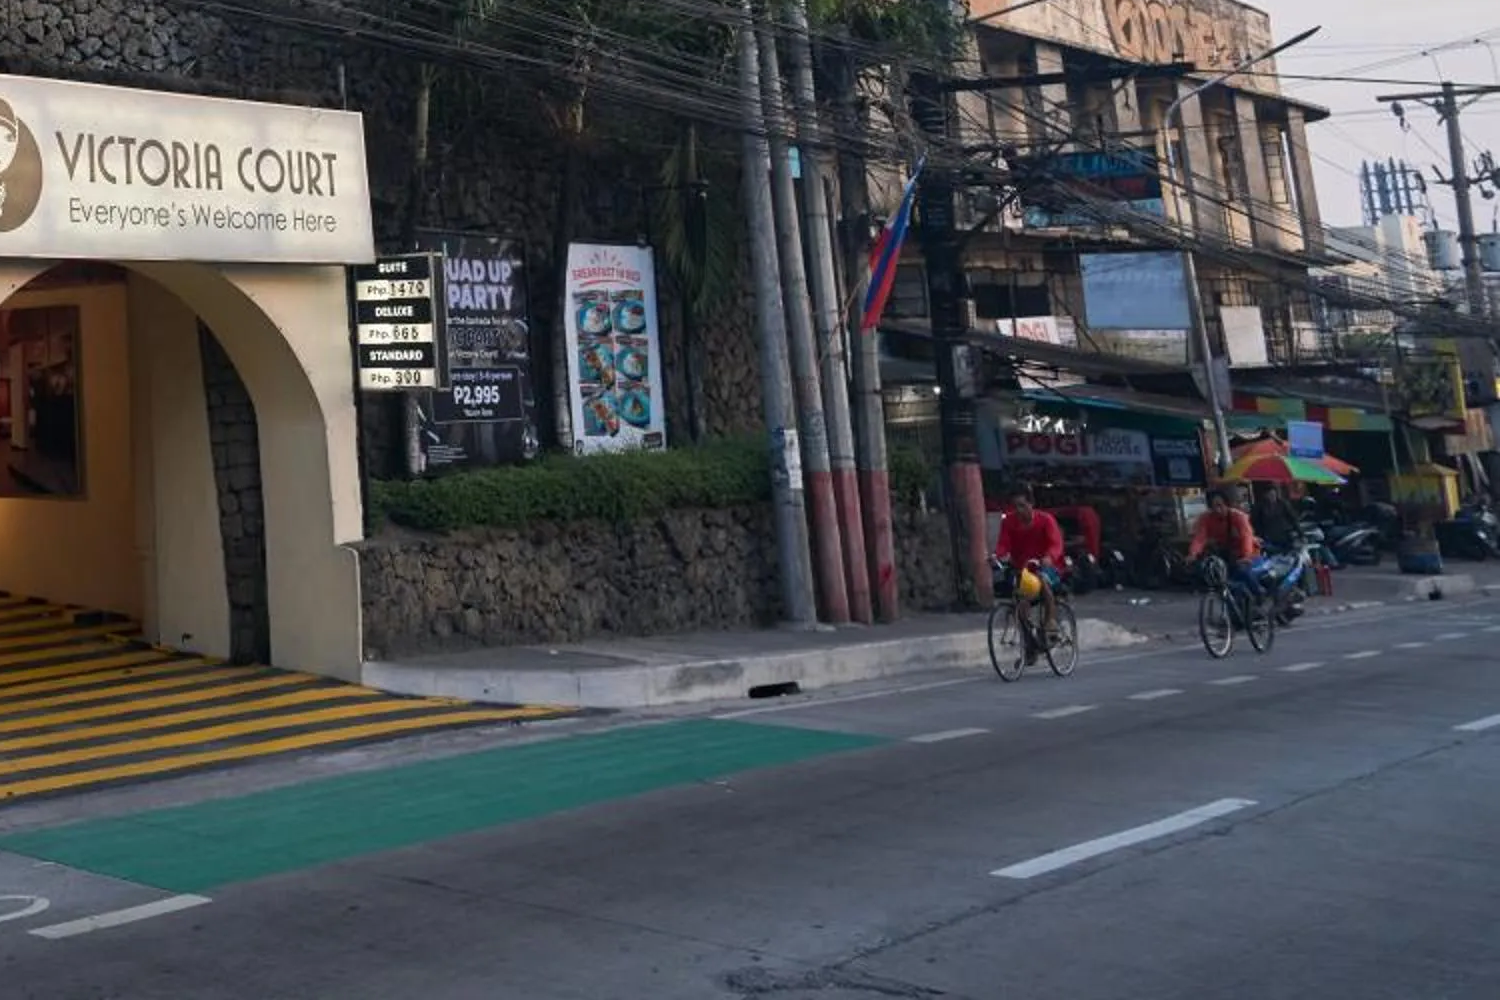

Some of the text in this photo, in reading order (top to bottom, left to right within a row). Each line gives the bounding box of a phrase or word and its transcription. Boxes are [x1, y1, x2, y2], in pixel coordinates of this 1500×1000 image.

[55, 131, 338, 197] VICTORIA COURT
[69, 197, 338, 233] Everyone's Welcome Here
[378, 262, 408, 273] SUITE
[488, 259, 512, 283] UP
[447, 284, 513, 311] PARTY
[375, 306, 414, 317] DELUXE
[369, 350, 423, 361] STANDARD
[1005, 433, 1088, 457] POGI
